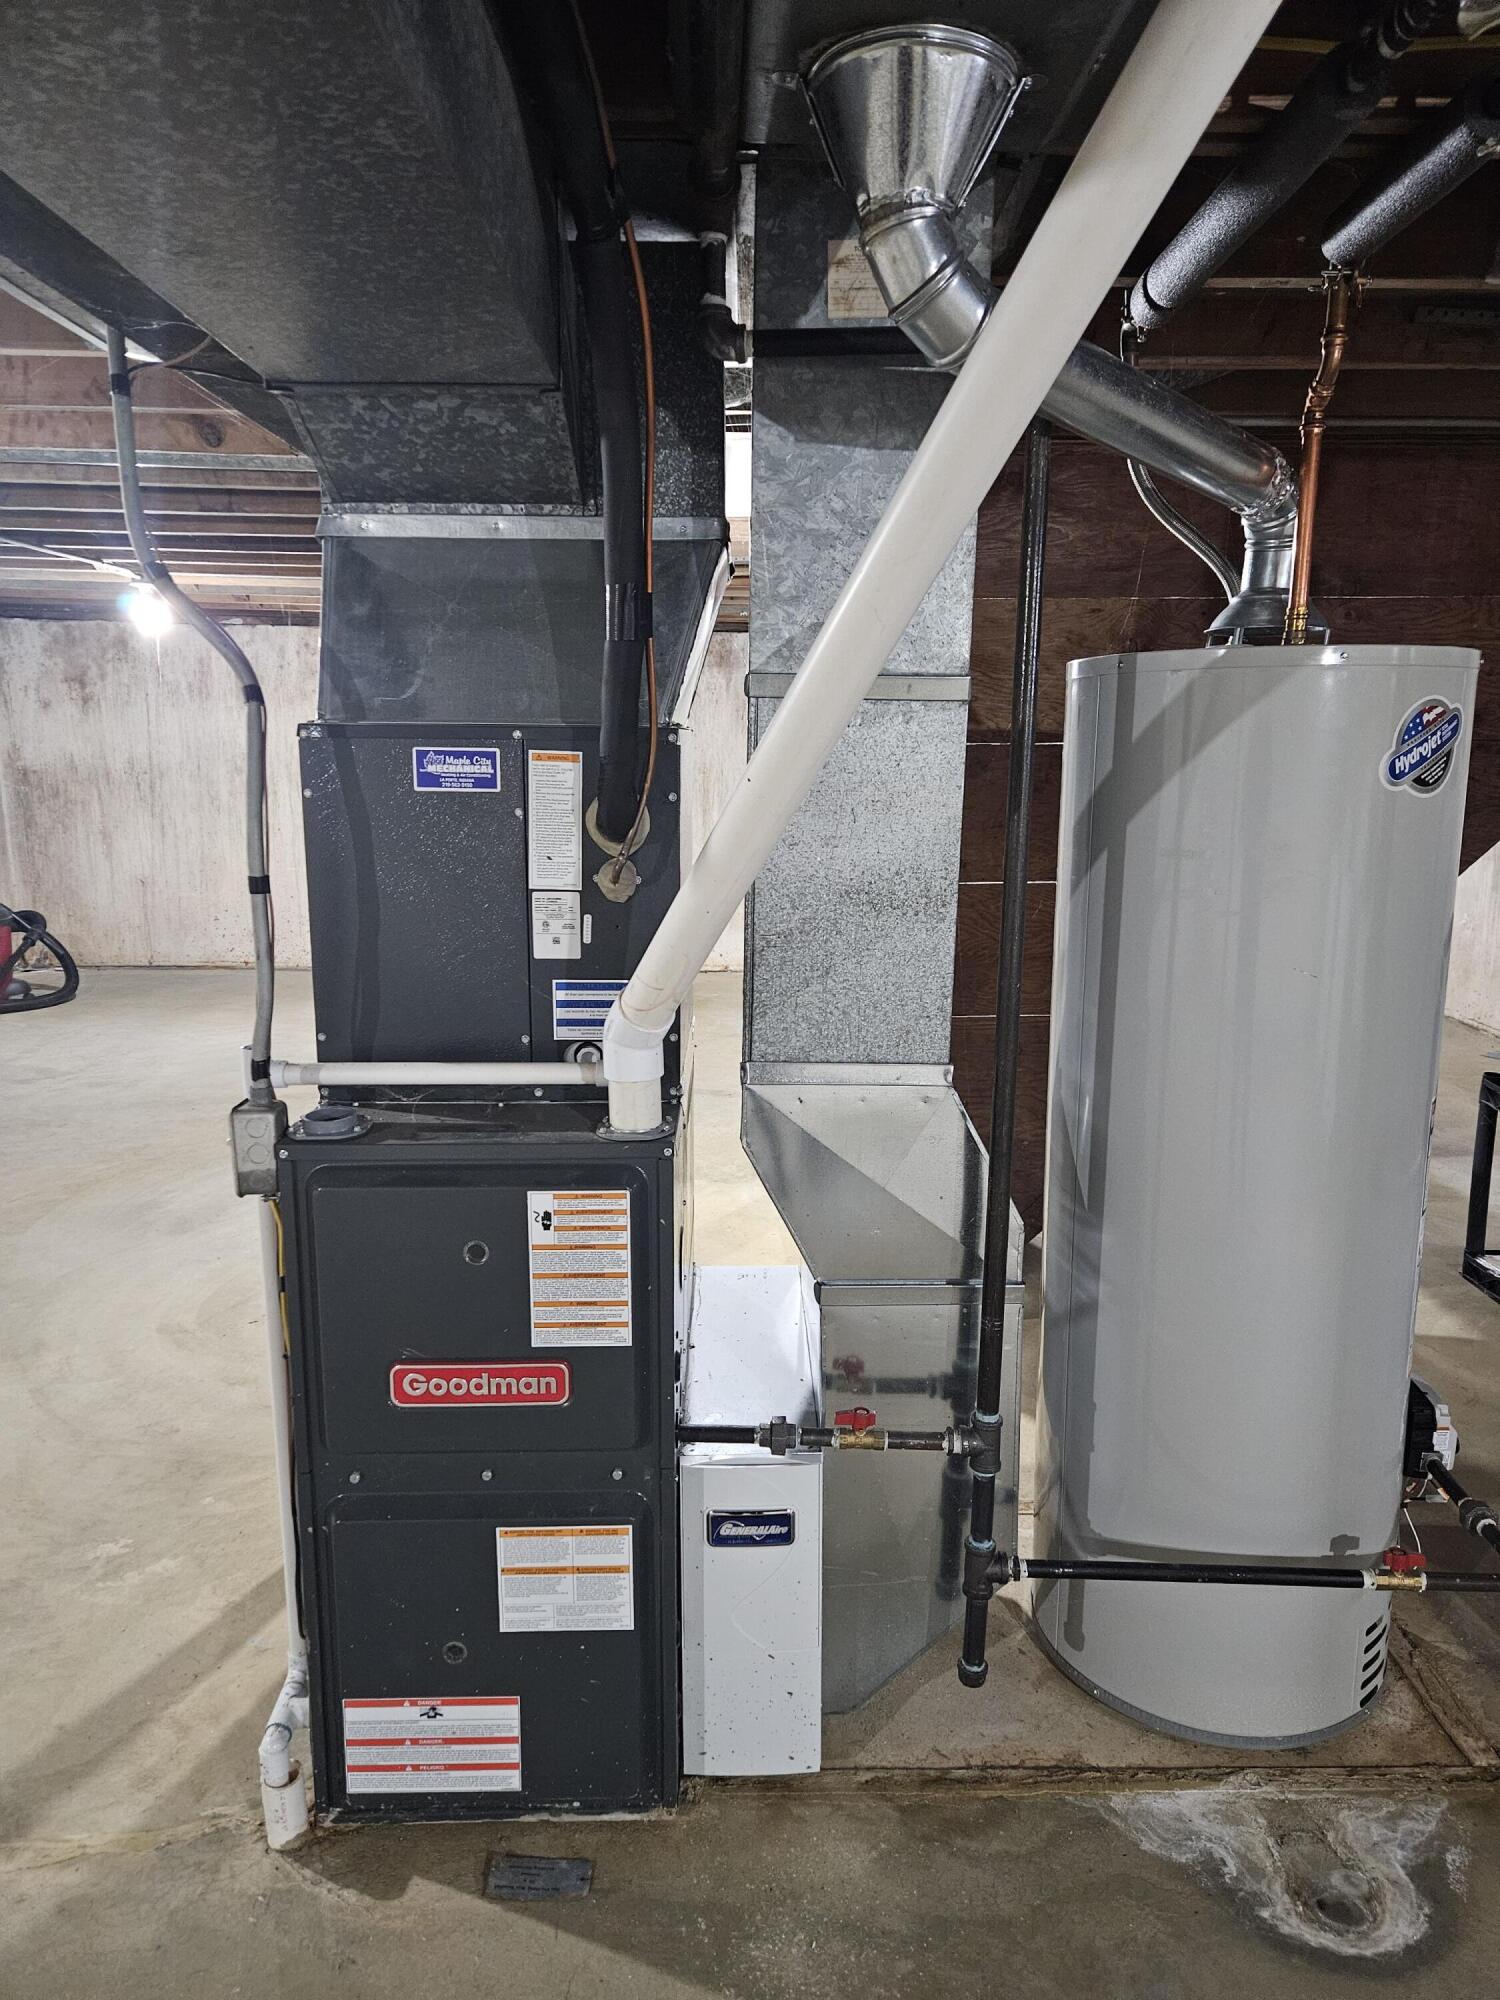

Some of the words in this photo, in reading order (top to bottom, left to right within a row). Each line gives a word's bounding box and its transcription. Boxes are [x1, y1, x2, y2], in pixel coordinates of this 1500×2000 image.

[445, 755, 471, 766] Maple
[473, 756, 492, 766] City
[1395, 729, 1441, 775] Hydrojet
[427, 764, 494, 773] MECHANICAL
[402, 1373, 557, 1397] Goodman
